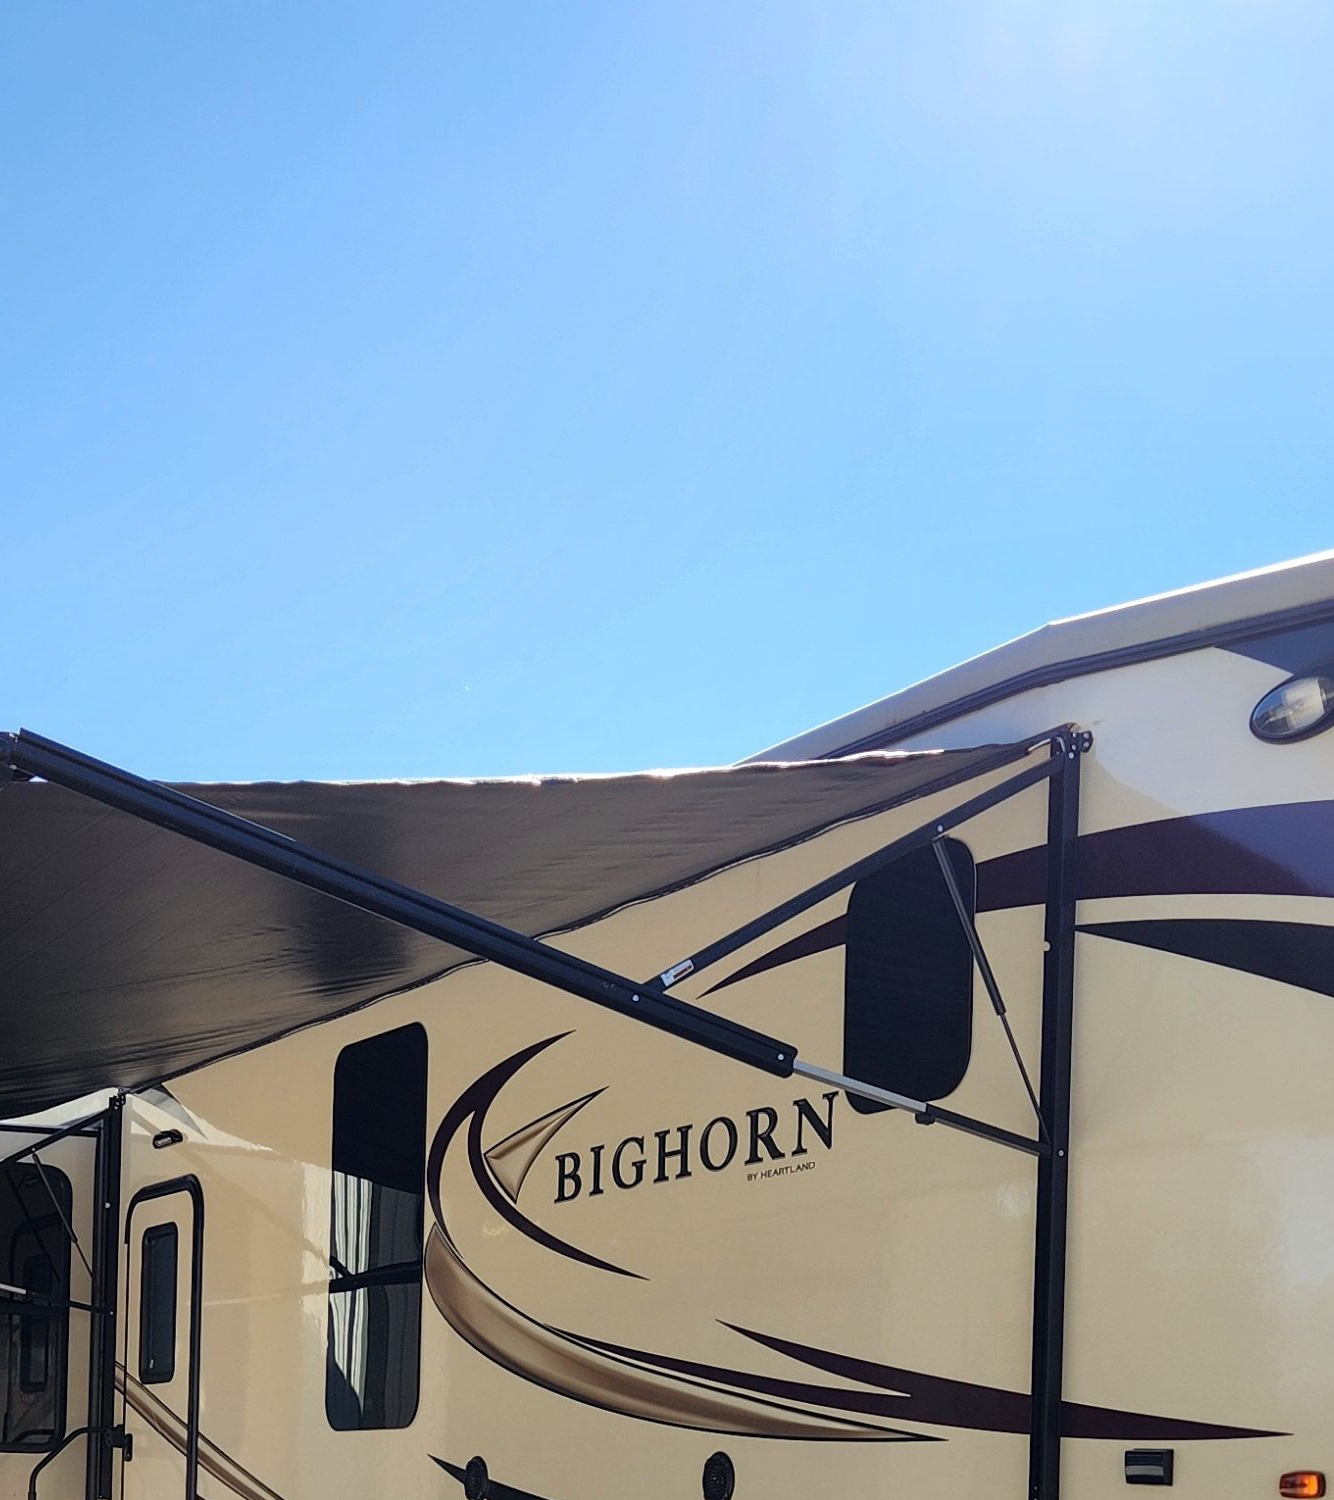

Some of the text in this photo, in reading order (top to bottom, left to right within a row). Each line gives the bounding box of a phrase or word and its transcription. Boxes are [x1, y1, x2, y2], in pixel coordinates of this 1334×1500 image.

[553, 1090, 839, 1204] BIGHORN
[747, 1161, 816, 1181] BY HEARTLAND
